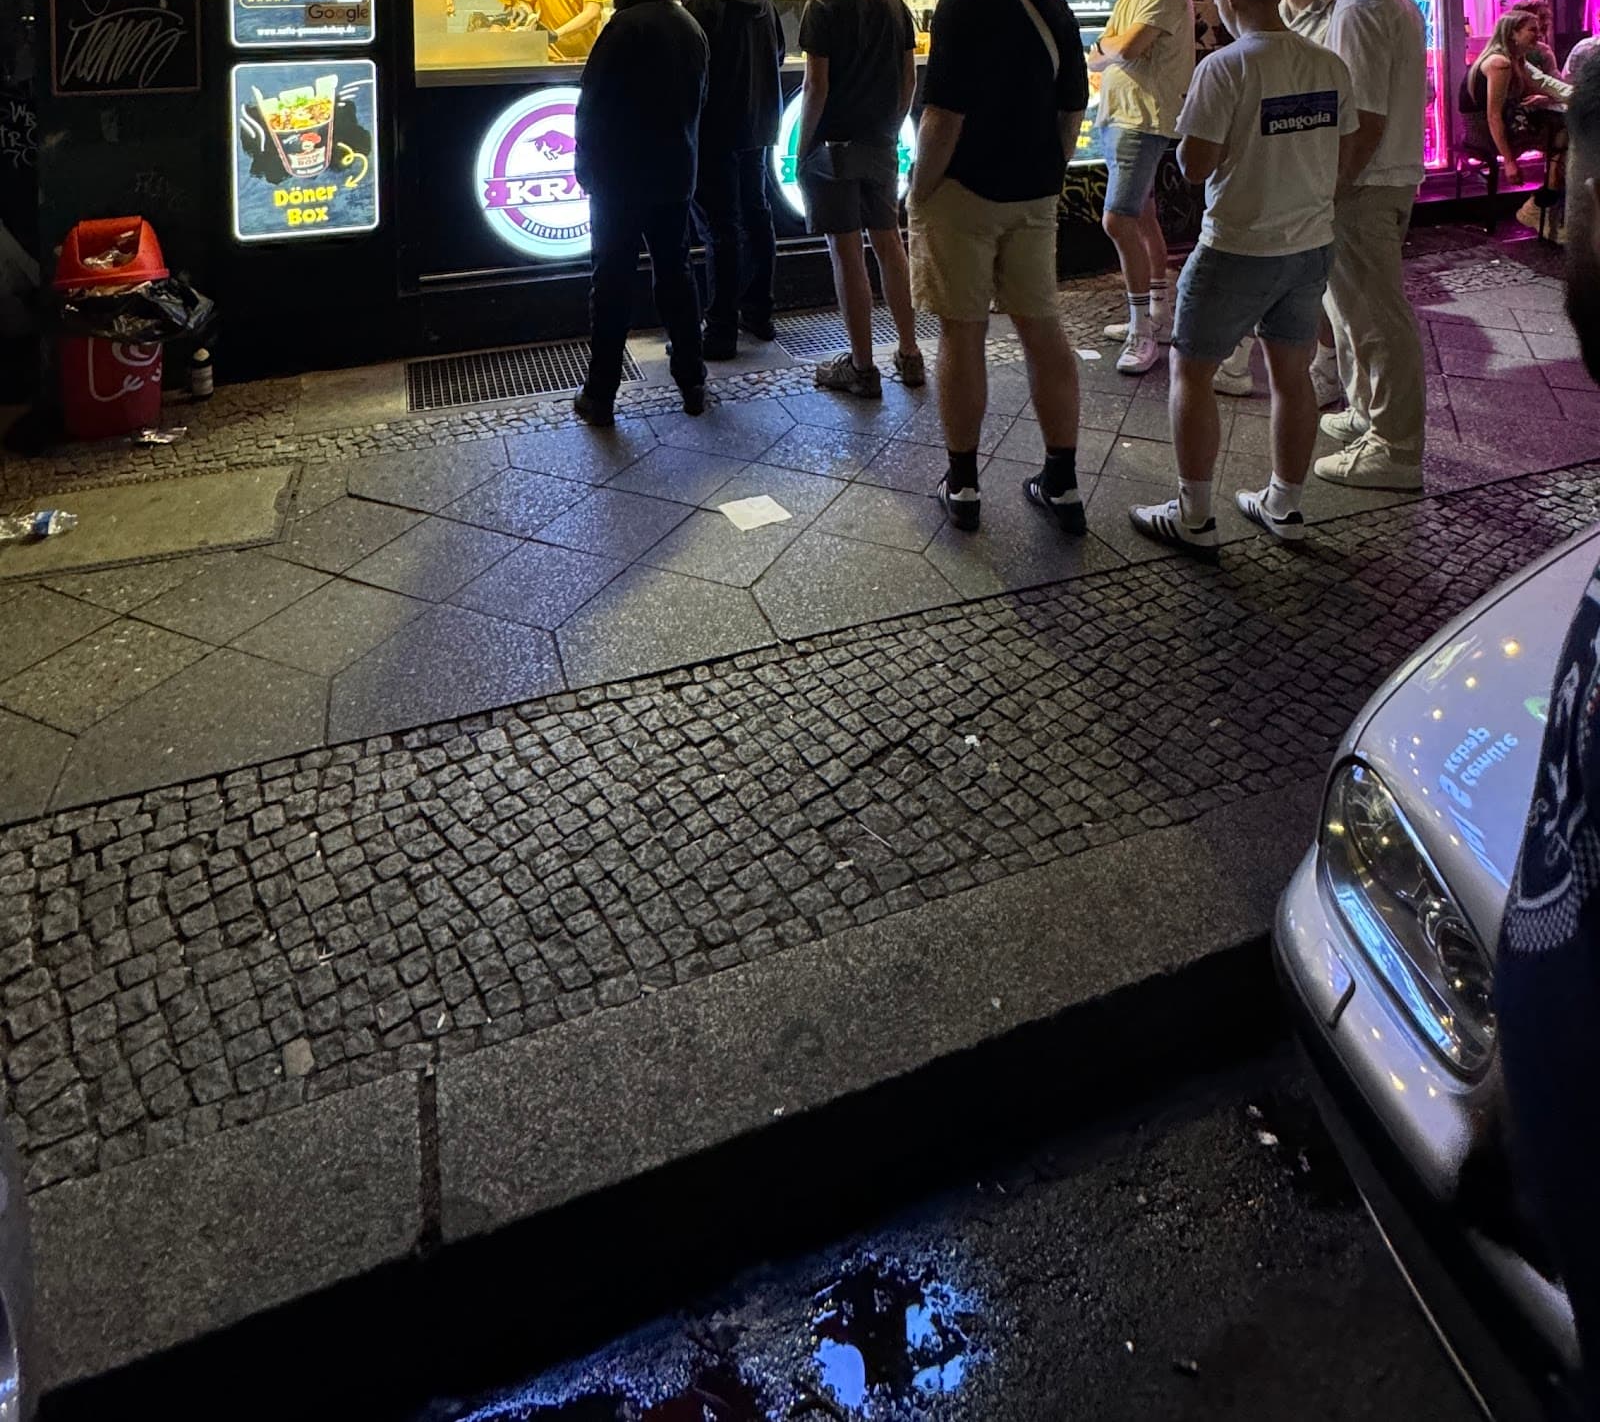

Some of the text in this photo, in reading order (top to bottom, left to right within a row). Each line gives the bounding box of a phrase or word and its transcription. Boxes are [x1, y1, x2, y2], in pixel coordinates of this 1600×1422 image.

[308, 4, 369, 23] Google
[273, 184, 338, 207] Döner
[287, 206, 329, 227] Box
